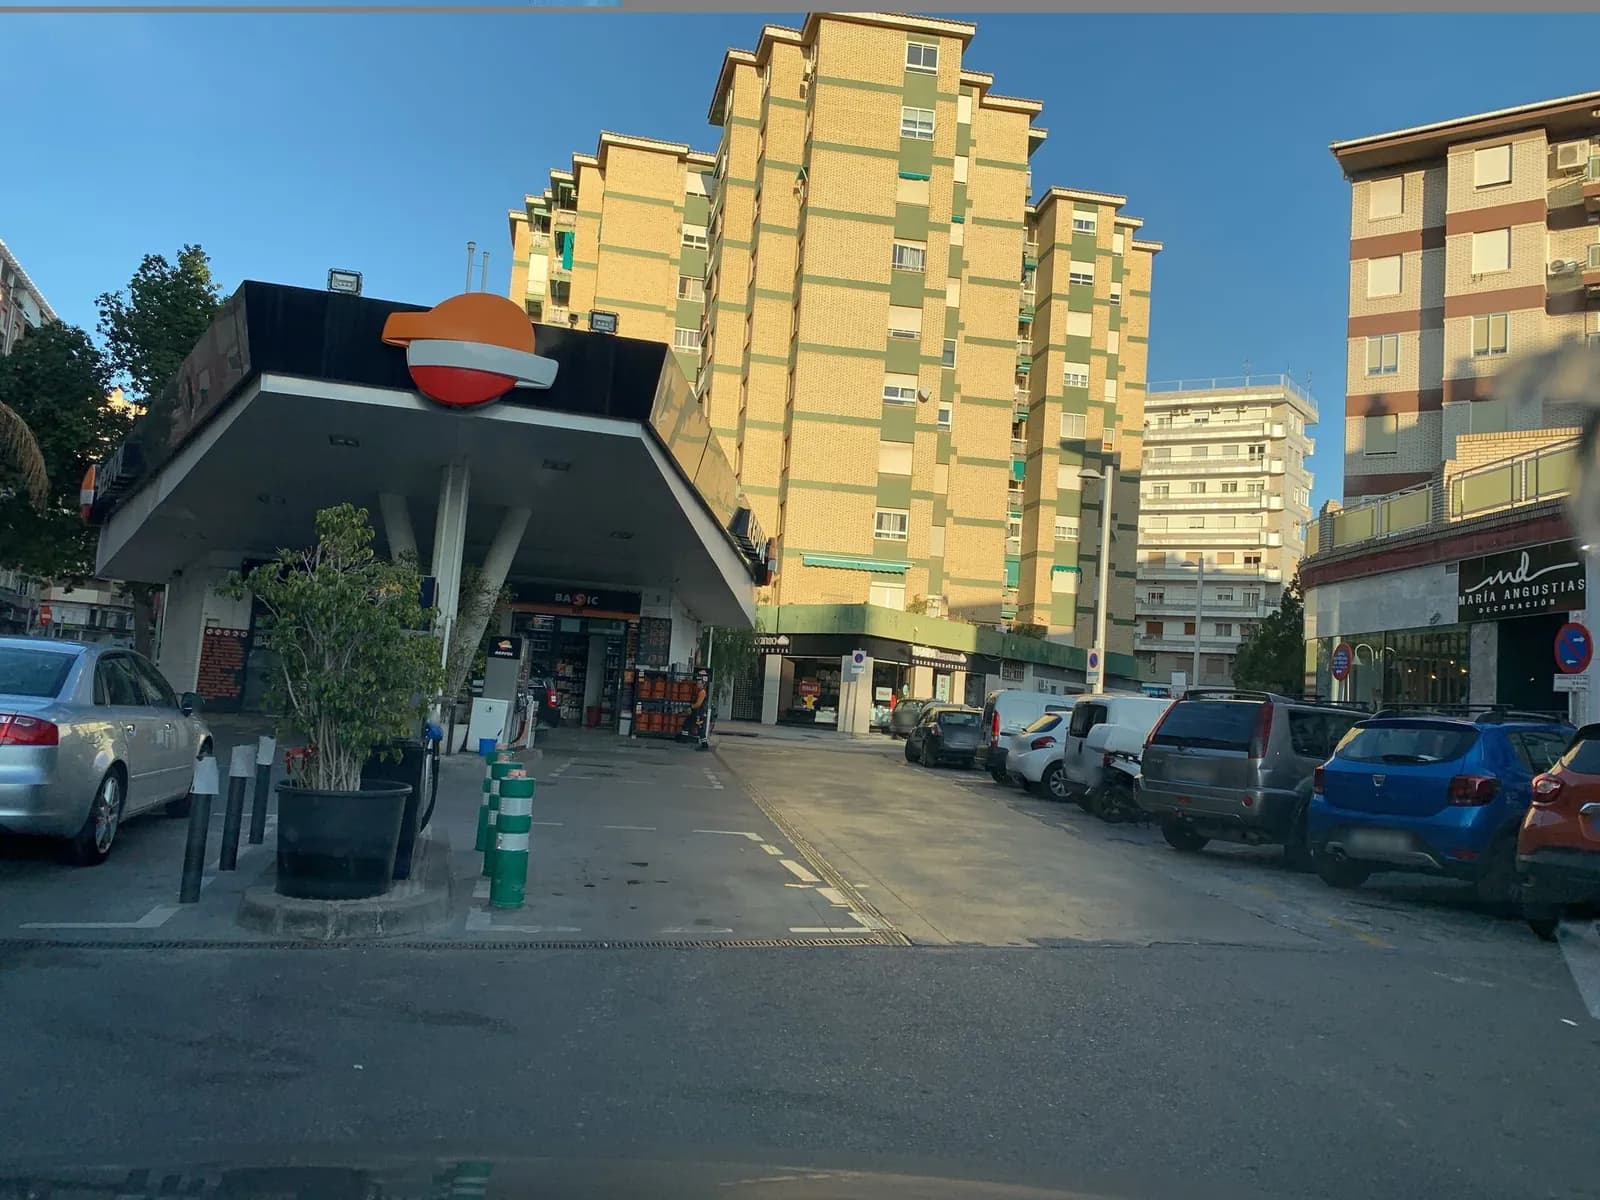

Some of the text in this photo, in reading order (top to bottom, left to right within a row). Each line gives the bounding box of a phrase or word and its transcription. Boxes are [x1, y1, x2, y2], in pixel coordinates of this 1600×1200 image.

[554, 593, 600, 606] BASIC
[1458, 579, 1585, 606] MARÍA ANGUSTIAS
[1479, 598, 1556, 614] DECORACIÓN
